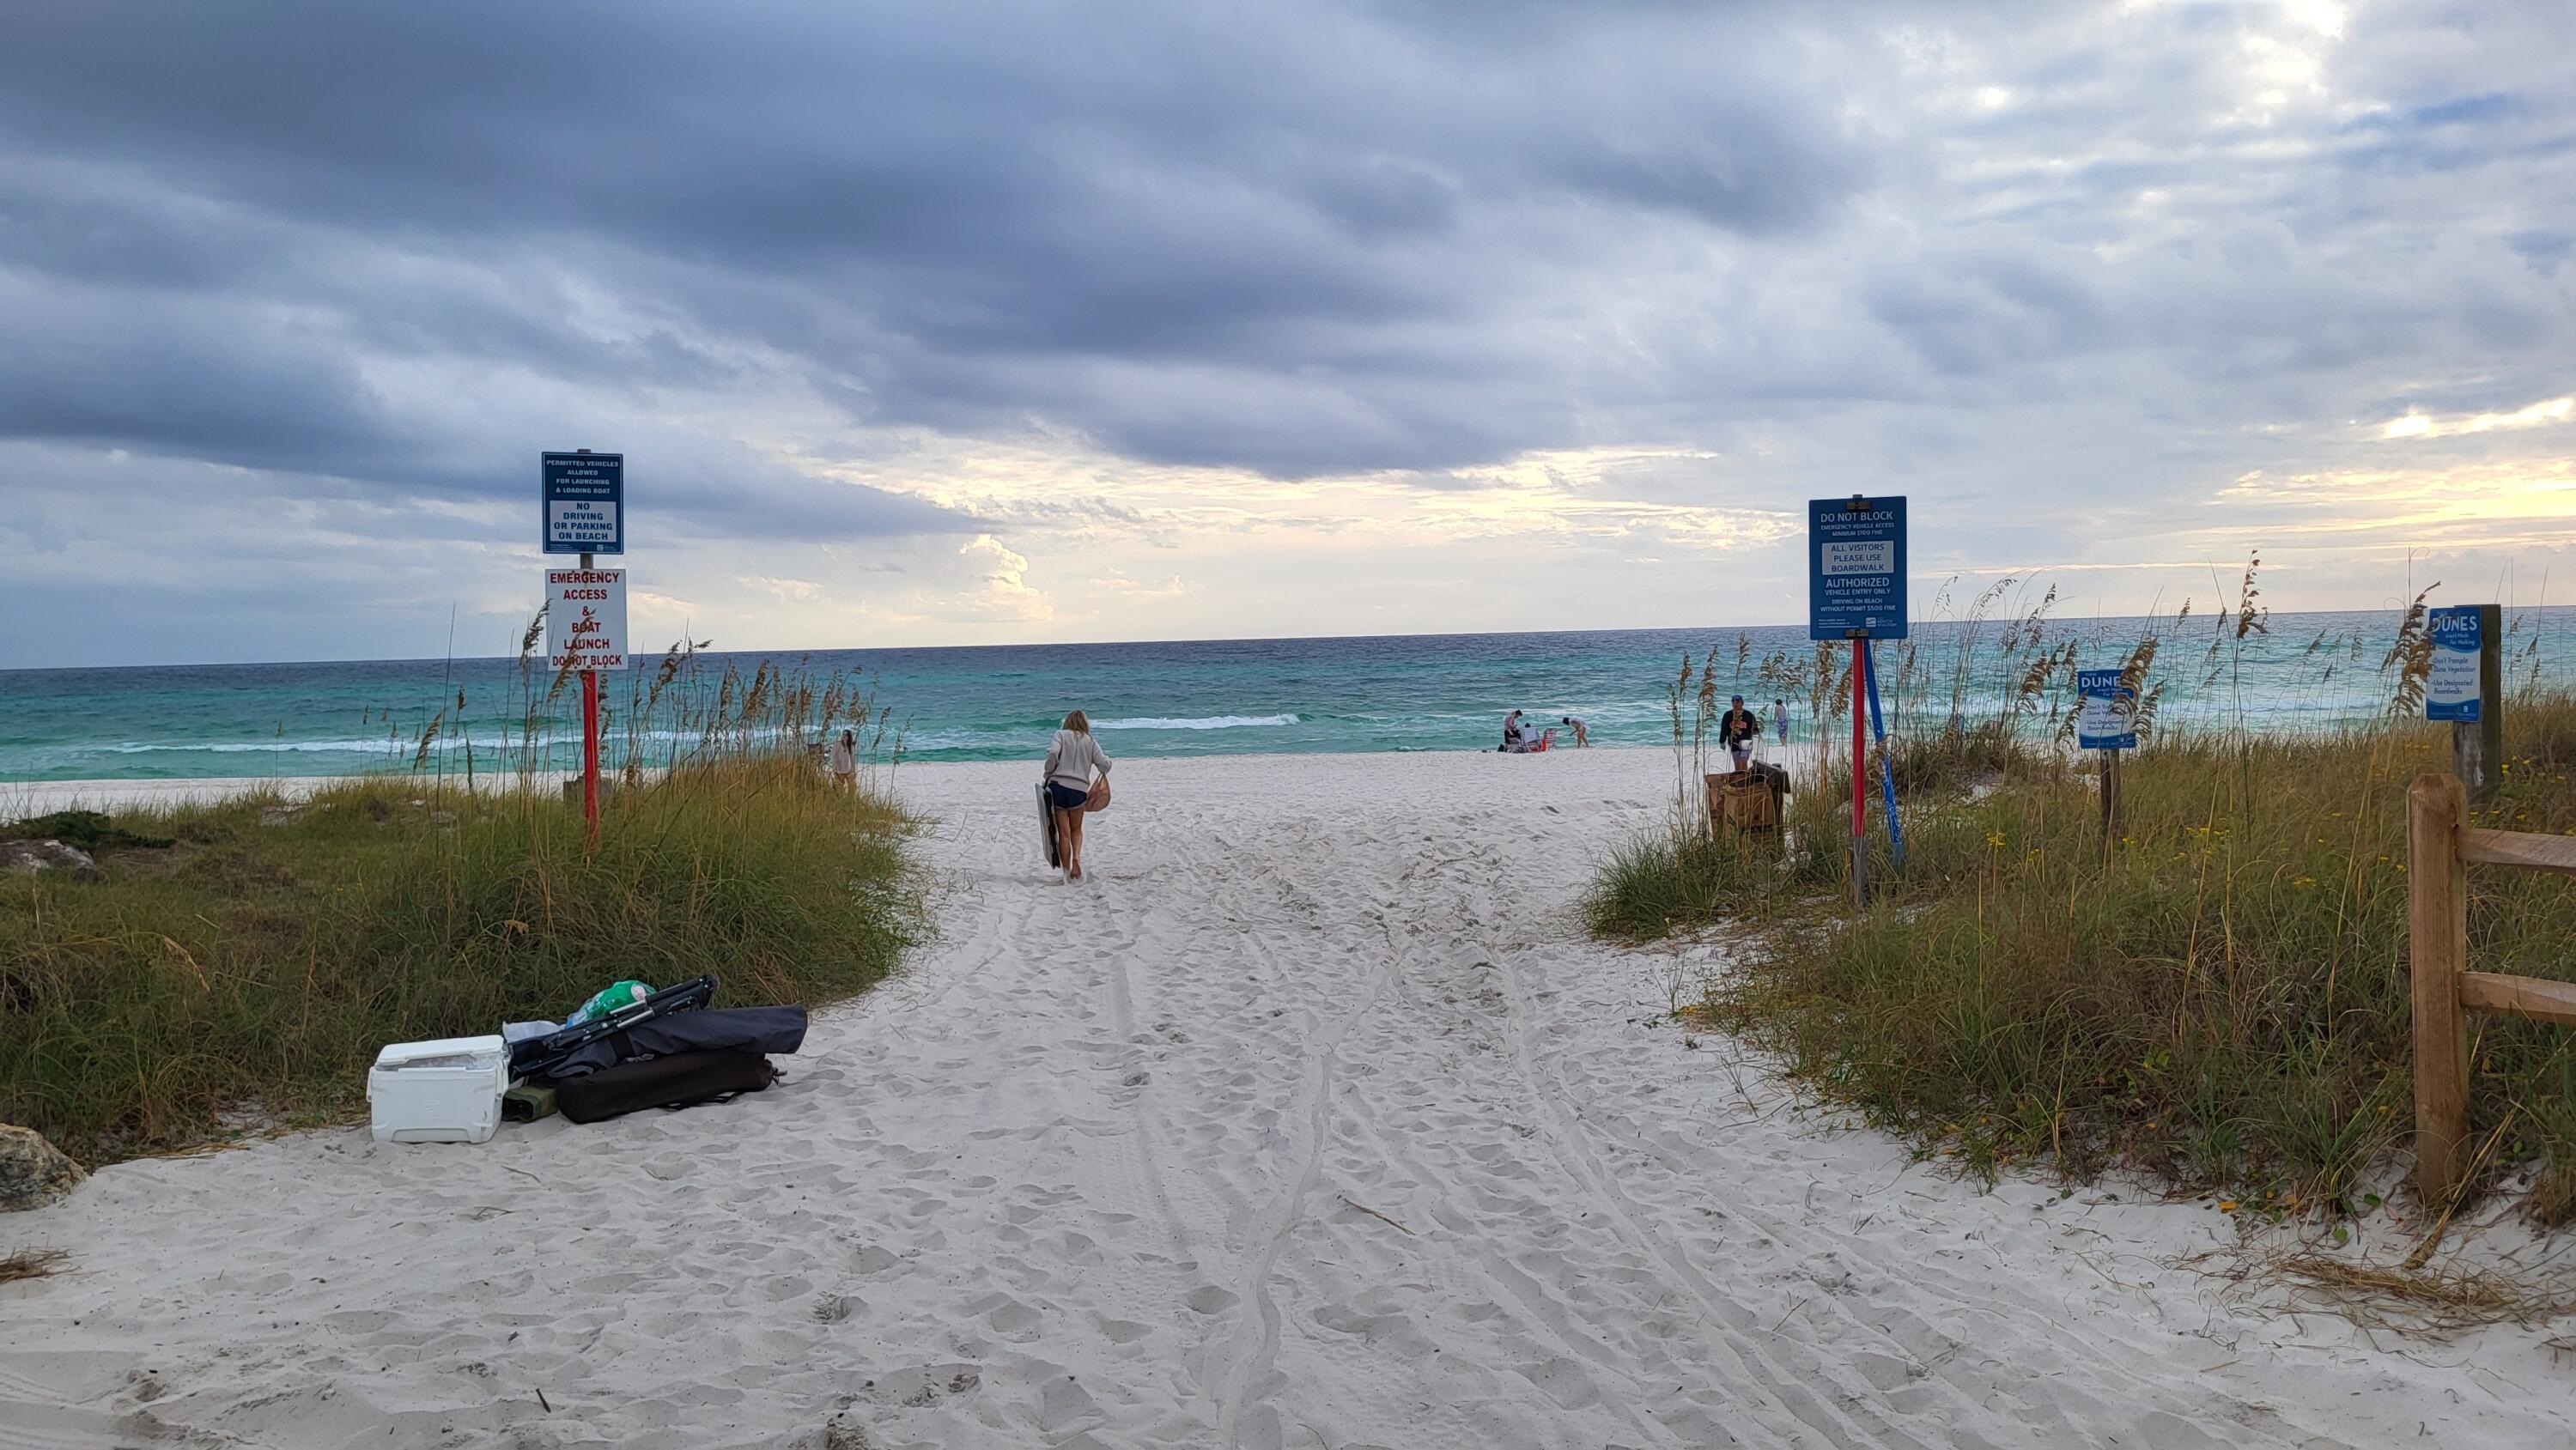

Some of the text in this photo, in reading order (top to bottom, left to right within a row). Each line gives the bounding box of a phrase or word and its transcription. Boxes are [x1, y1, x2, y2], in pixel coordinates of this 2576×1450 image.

[1821, 511, 1893, 522] DO NOT BLOCK
[550, 573, 619, 584] EMERGENCY
[1826, 578, 1889, 588] AUTHORIZED
[563, 590, 607, 599] ACCESS
[582, 606, 589, 616] &
[2433, 616, 2477, 632] DUNES
[564, 639, 610, 649] LAUNCH
[553, 656, 566, 666] DO
[591, 655, 622, 665] BLOCK
